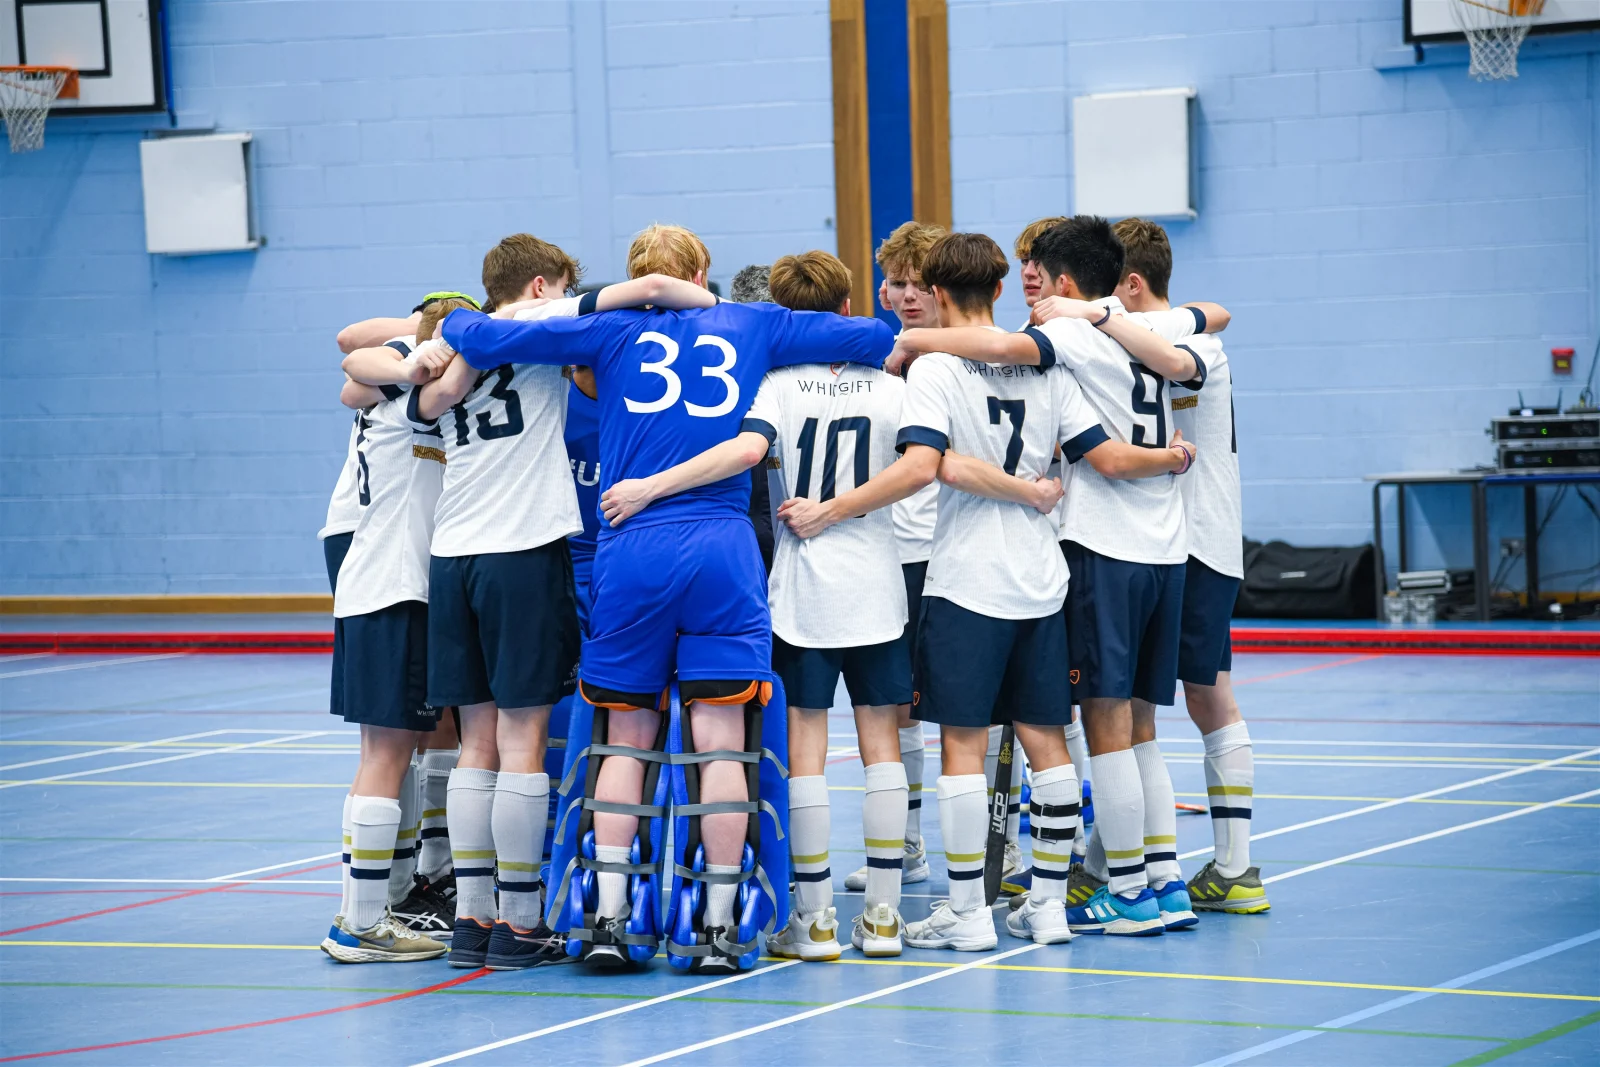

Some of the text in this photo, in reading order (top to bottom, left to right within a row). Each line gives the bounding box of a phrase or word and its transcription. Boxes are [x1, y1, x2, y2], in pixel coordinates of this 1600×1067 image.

[455, 362, 525, 447] 13
[623, 331, 740, 418] 33
[1129, 361, 1167, 449] 9
[795, 416, 871, 518] 10
[986, 396, 1026, 477] 7
